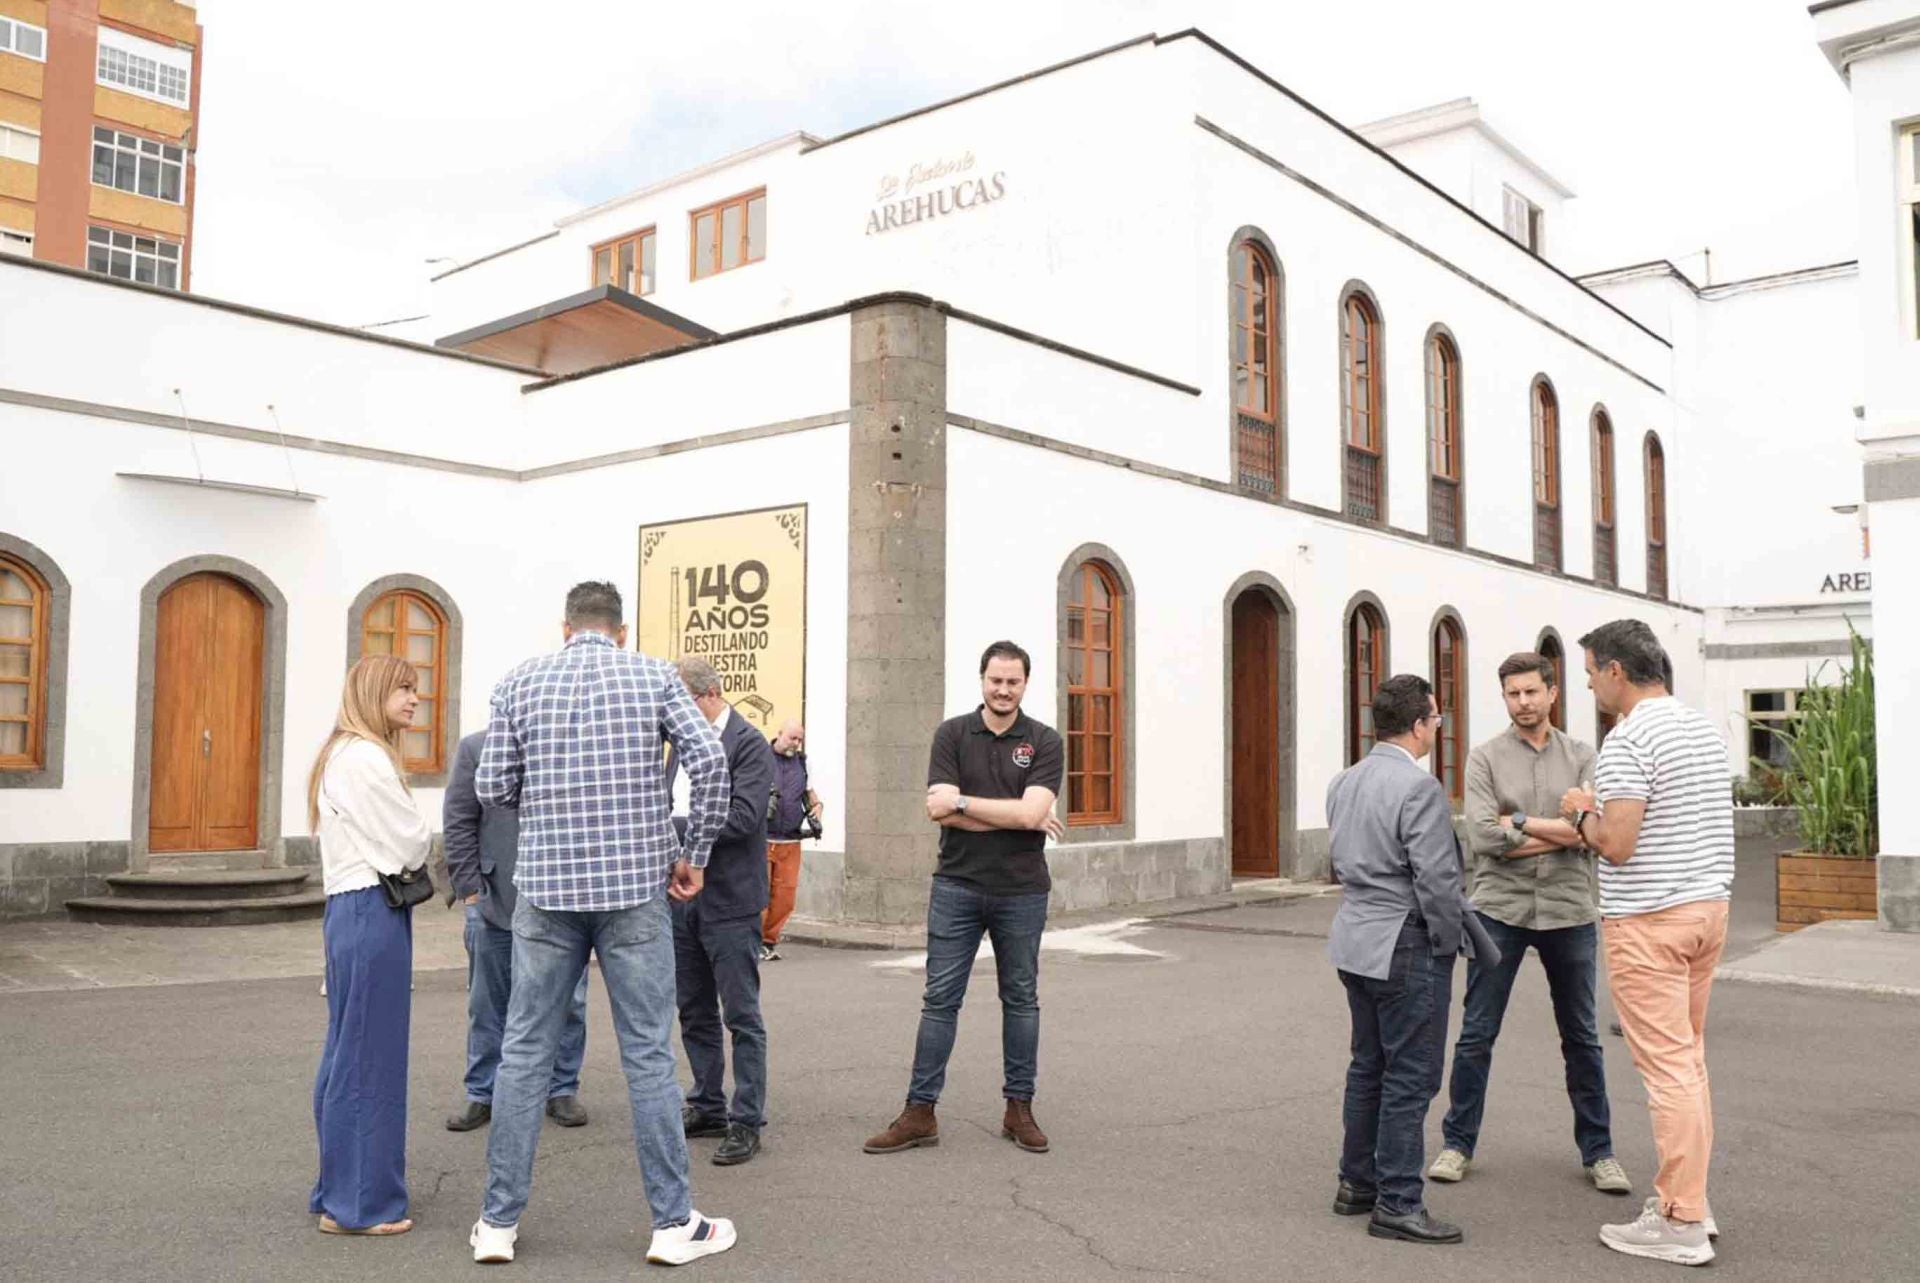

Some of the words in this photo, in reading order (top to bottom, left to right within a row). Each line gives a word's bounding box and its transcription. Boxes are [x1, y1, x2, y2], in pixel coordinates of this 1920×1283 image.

[865, 170, 1006, 236] AREHUCAS
[685, 559, 770, 607] 140
[685, 603, 770, 632] AÑOS
[684, 630, 769, 653] DESTILANDO
[720, 673, 757, 692] ORIA
